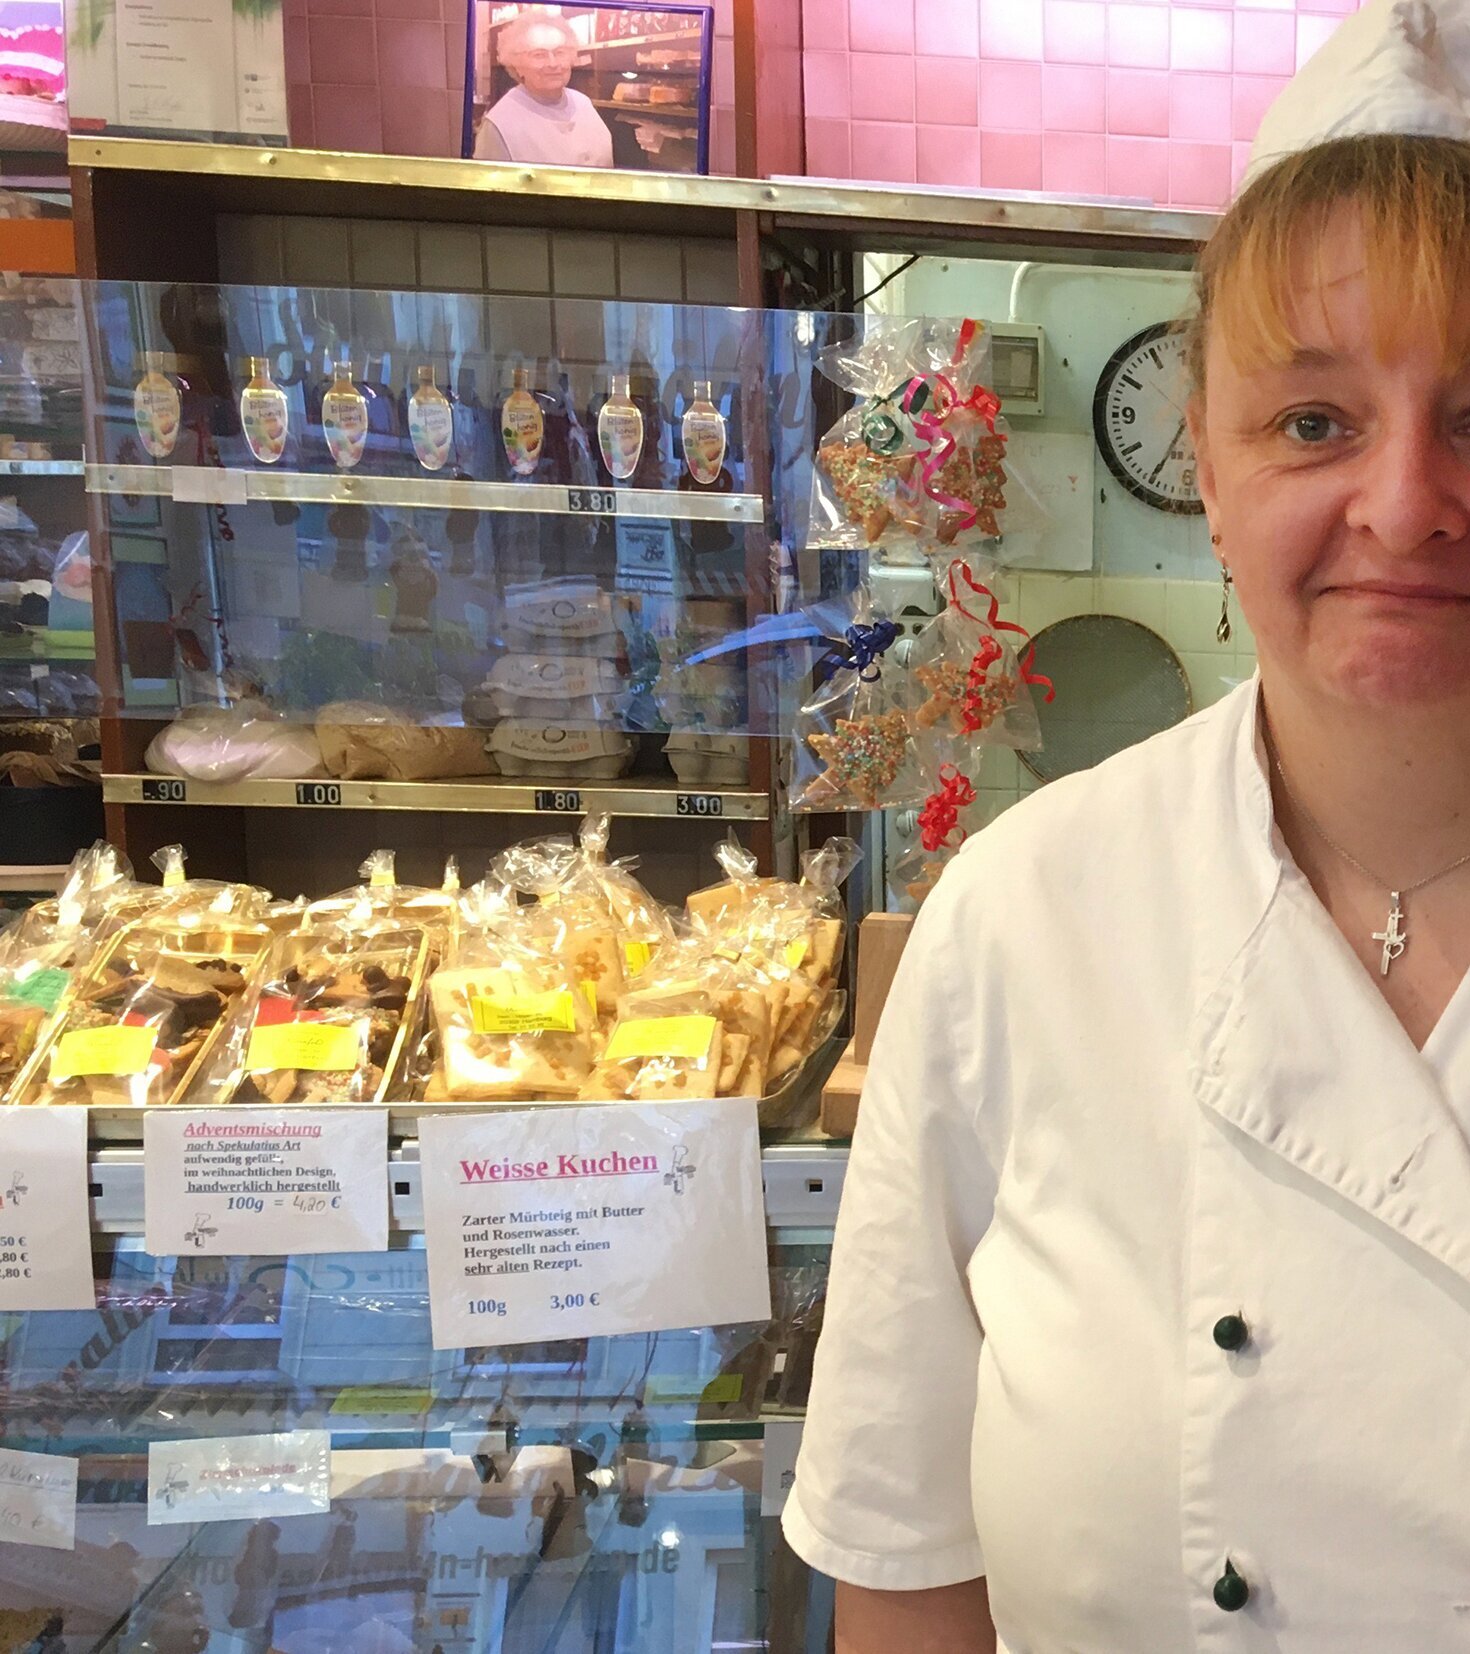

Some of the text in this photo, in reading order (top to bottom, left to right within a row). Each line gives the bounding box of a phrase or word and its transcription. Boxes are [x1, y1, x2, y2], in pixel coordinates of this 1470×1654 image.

[1121, 406, 1136, 425] 9
[570, 491, 616, 512] 3.80
[297, 785, 340, 804] 1.00
[536, 791, 578, 810] 1.80
[677, 795, 722, 815] 3.00
[183, 1121, 322, 1138] Adventsmischung
[187, 1140, 301, 1152] nach Spekulatius Art
[184, 1154, 242, 1165] aufwendig
[459, 1151, 659, 1183] Weisse Kuchen
[184, 1167, 336, 1179] im weihnachtlichen Design,
[187, 1180, 341, 1193] handwerklich hergestellt
[227, 1197, 264, 1213] 100g
[331, 1196, 342, 1209] €
[461, 1204, 645, 1227] Zarter Mürbteig mit Butter
[18, 1236, 28, 1247] €
[462, 1225, 580, 1243] und Rosenwasser.
[20, 1252, 30, 1263] €
[463, 1239, 611, 1260] Hergestellt nach einen
[24, 1267, 32, 1279] €
[464, 1256, 583, 1276] sehr alten Rezept.
[468, 1292, 601, 1316] 100g 3,00 €
